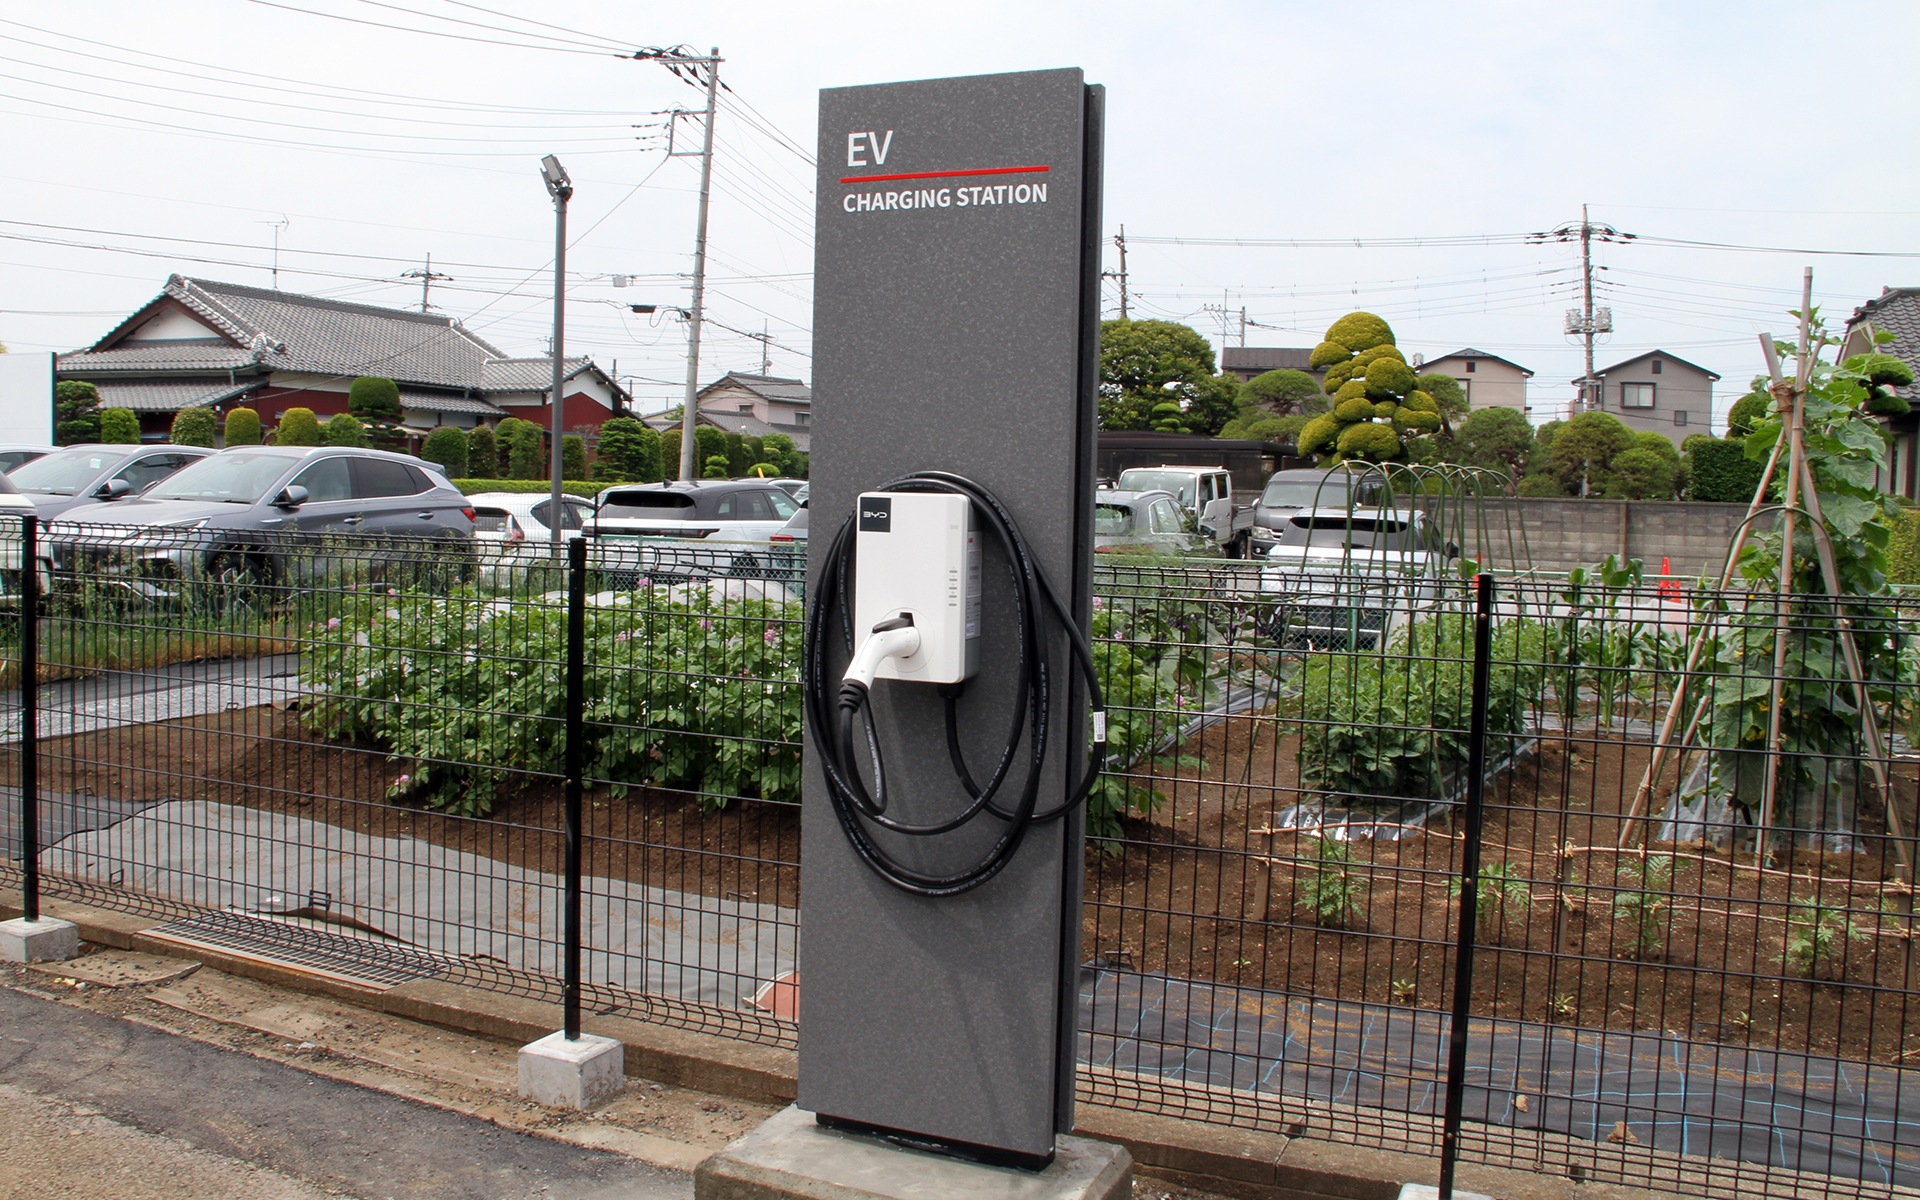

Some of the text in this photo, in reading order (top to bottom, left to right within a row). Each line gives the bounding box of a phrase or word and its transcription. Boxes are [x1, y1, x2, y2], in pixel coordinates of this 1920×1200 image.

[847, 130, 893, 167] EV
[843, 183, 1047, 212] CHARGING STATION
[863, 511, 888, 519] BYD
